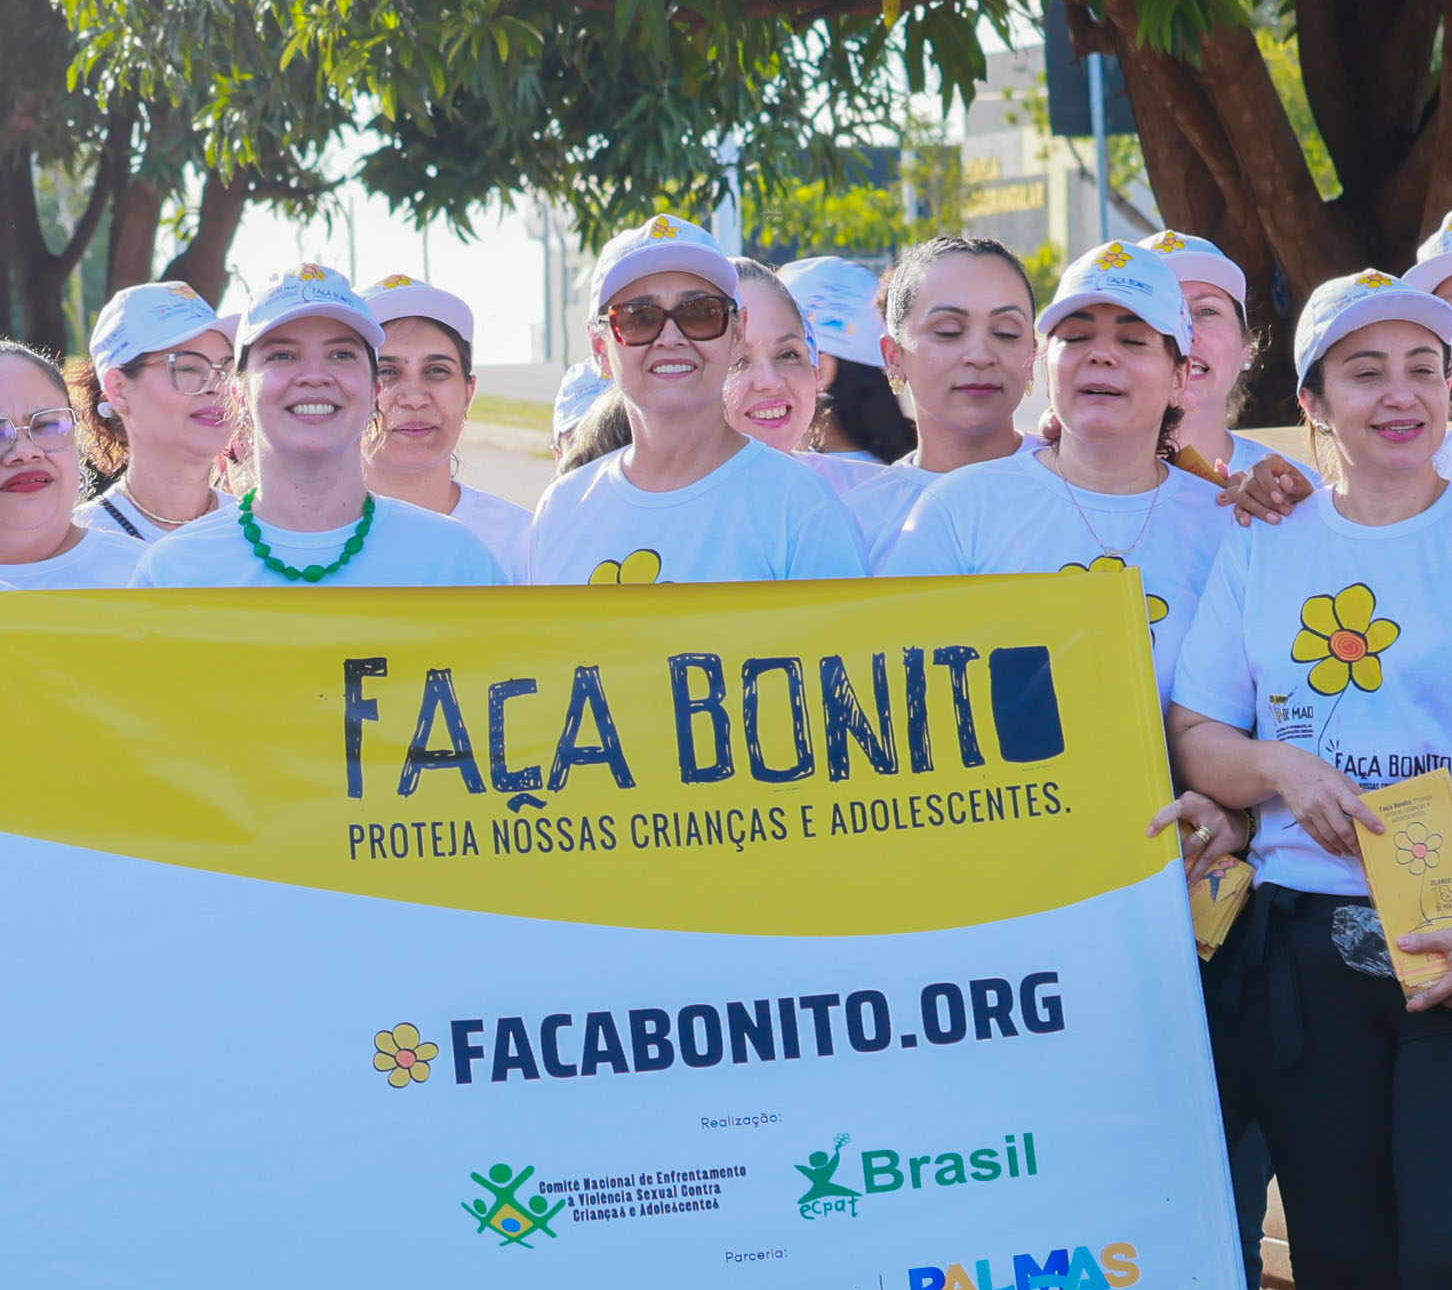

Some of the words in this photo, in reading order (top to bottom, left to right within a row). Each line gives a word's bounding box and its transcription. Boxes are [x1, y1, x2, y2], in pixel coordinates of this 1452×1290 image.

[344, 656, 637, 813] FAÇA
[667, 645, 1065, 784] BONITO
[1335, 752, 1382, 780] FAÇA
[348, 820, 480, 860] PROTEJA
[492, 813, 617, 855] NOSSAS
[630, 805, 788, 853] CRIANÇAS
[802, 804, 817, 839] E
[830, 781, 1072, 836] ADOLESCENTES.
[450, 971, 1066, 1085] FACABONITO.ORG
[700, 1111, 783, 1130] Realização:
[861, 1132, 1038, 1195] Brasil
[583, 1172, 636, 1191] Nacional
[639, 1172, 654, 1187] de
[656, 1164, 747, 1185] Enfrentamento
[578, 1189, 633, 1206] Violência
[637, 1185, 678, 1201] Sexual
[681, 1182, 722, 1198] Contra
[572, 1206, 626, 1223] Crianças
[629, 1205, 637, 1217] e
[639, 1199, 720, 1217] Adolescentes
[725, 1248, 788, 1264] Parceria:
